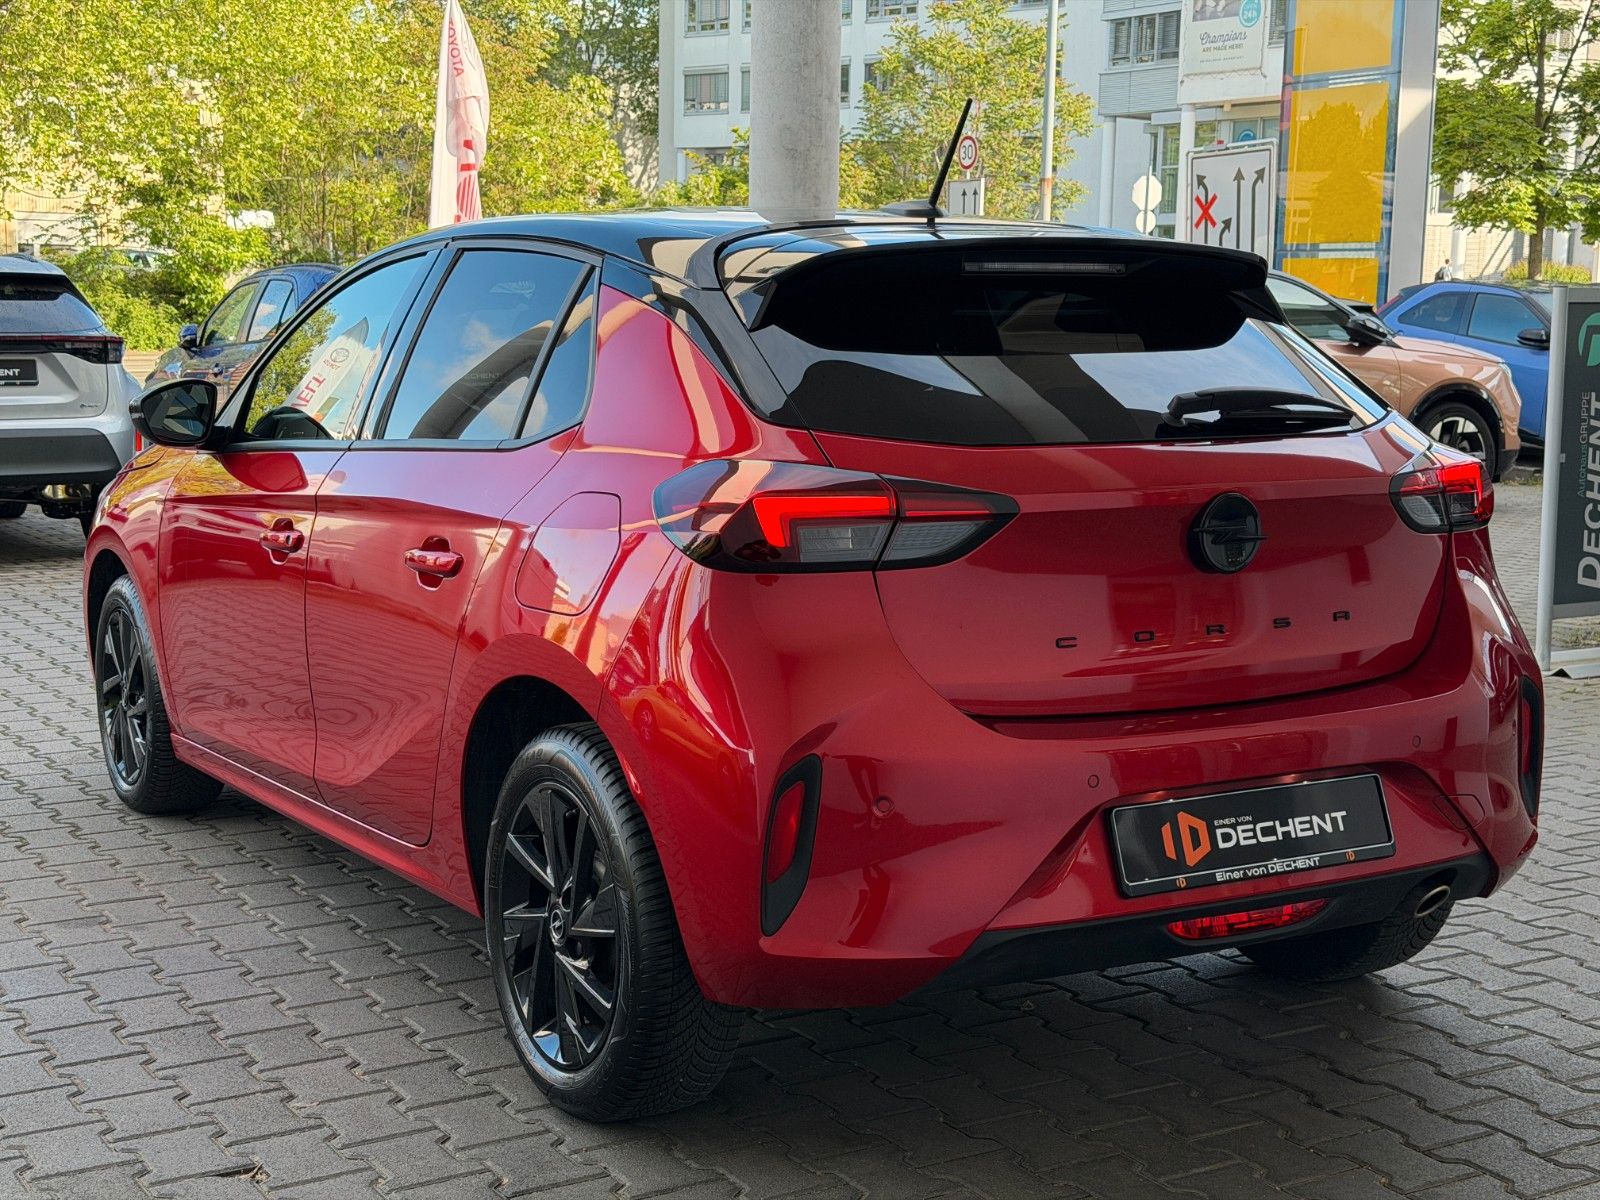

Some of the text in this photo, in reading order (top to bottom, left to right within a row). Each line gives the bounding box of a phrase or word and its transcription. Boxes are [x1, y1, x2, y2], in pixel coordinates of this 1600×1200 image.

[1200, 31, 1248, 45] Champions
[961, 144, 973, 160] 30
[1055, 610, 1351, 648] CORSA
[1214, 815, 1253, 826] EINER VON
[1215, 811, 1347, 849] DECHENT
[1216, 857, 1320, 881] Einer von DECHENT
